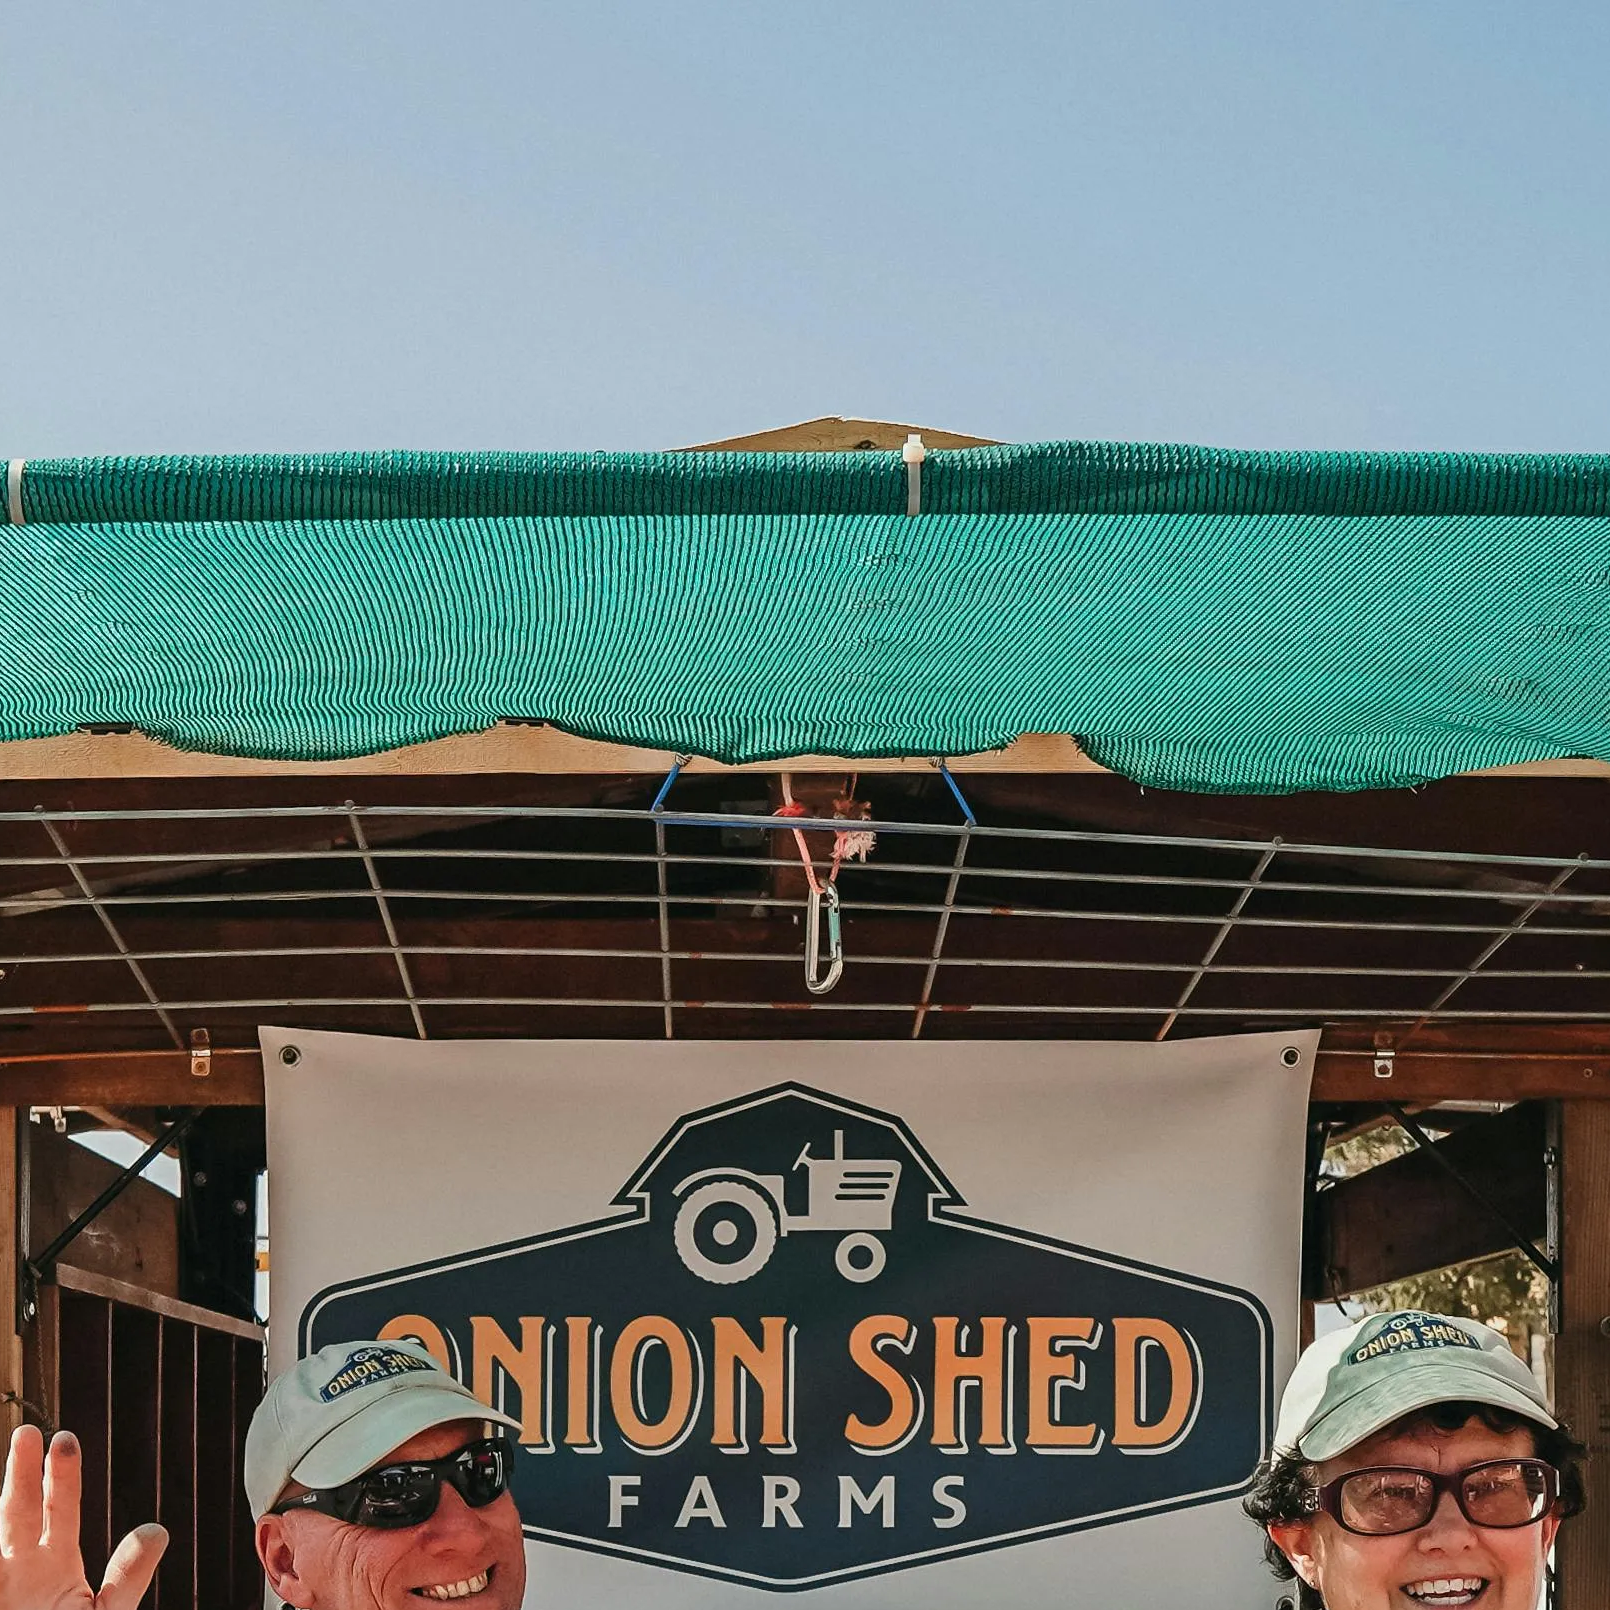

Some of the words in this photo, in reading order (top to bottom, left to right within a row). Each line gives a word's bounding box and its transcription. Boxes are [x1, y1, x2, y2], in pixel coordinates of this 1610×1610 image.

[1354, 1327, 1415, 1363] ONION
[327, 1359, 381, 1396] ONION
[845, 1312, 1202, 1455] SHED
[607, 1474, 968, 1529] FARMS
